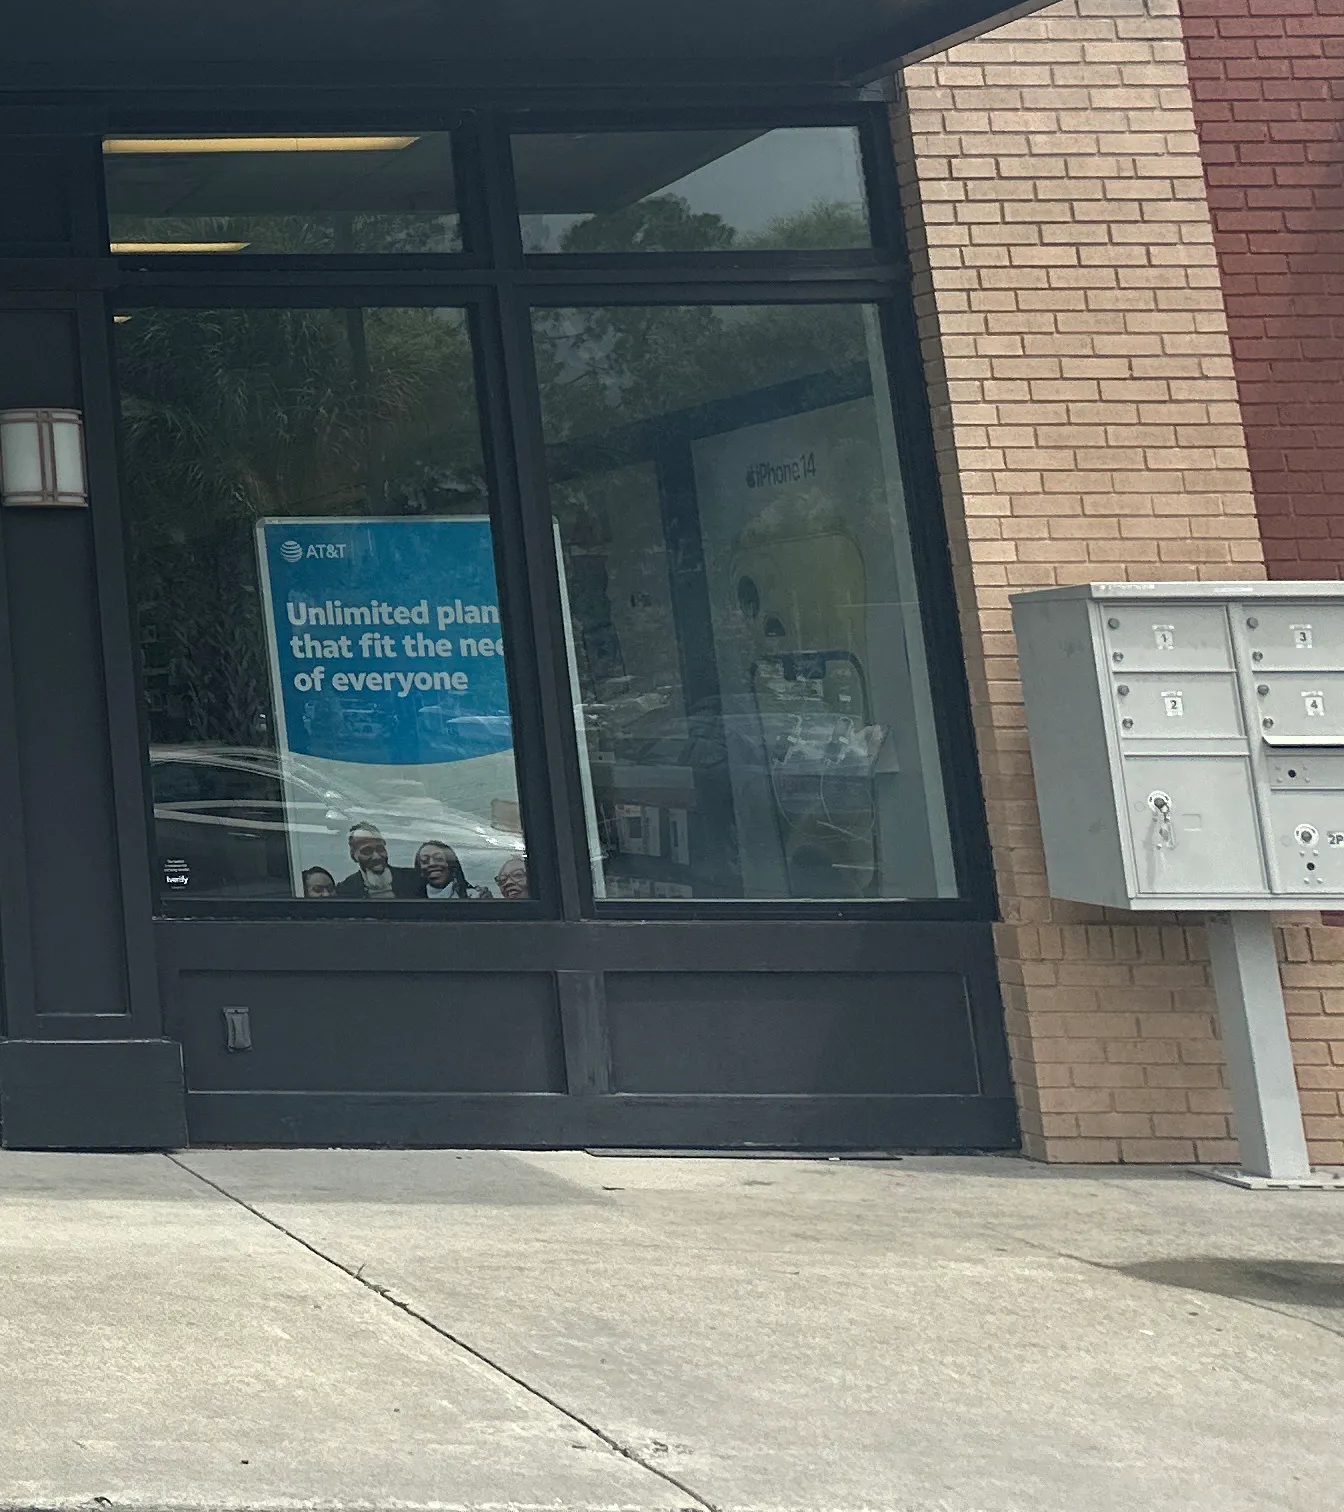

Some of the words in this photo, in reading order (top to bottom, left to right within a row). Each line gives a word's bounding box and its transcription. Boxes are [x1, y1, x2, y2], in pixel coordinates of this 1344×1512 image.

[756, 459, 801, 488] iPhone
[800, 451, 816, 480] 14
[306, 543, 347, 559] AT&T
[286, 599, 430, 626] Unlimited
[290, 632, 354, 659] that
[358, 632, 398, 658] fit
[402, 631, 453, 658] the
[293, 665, 326, 692] of
[331, 670, 469, 698] everyone
